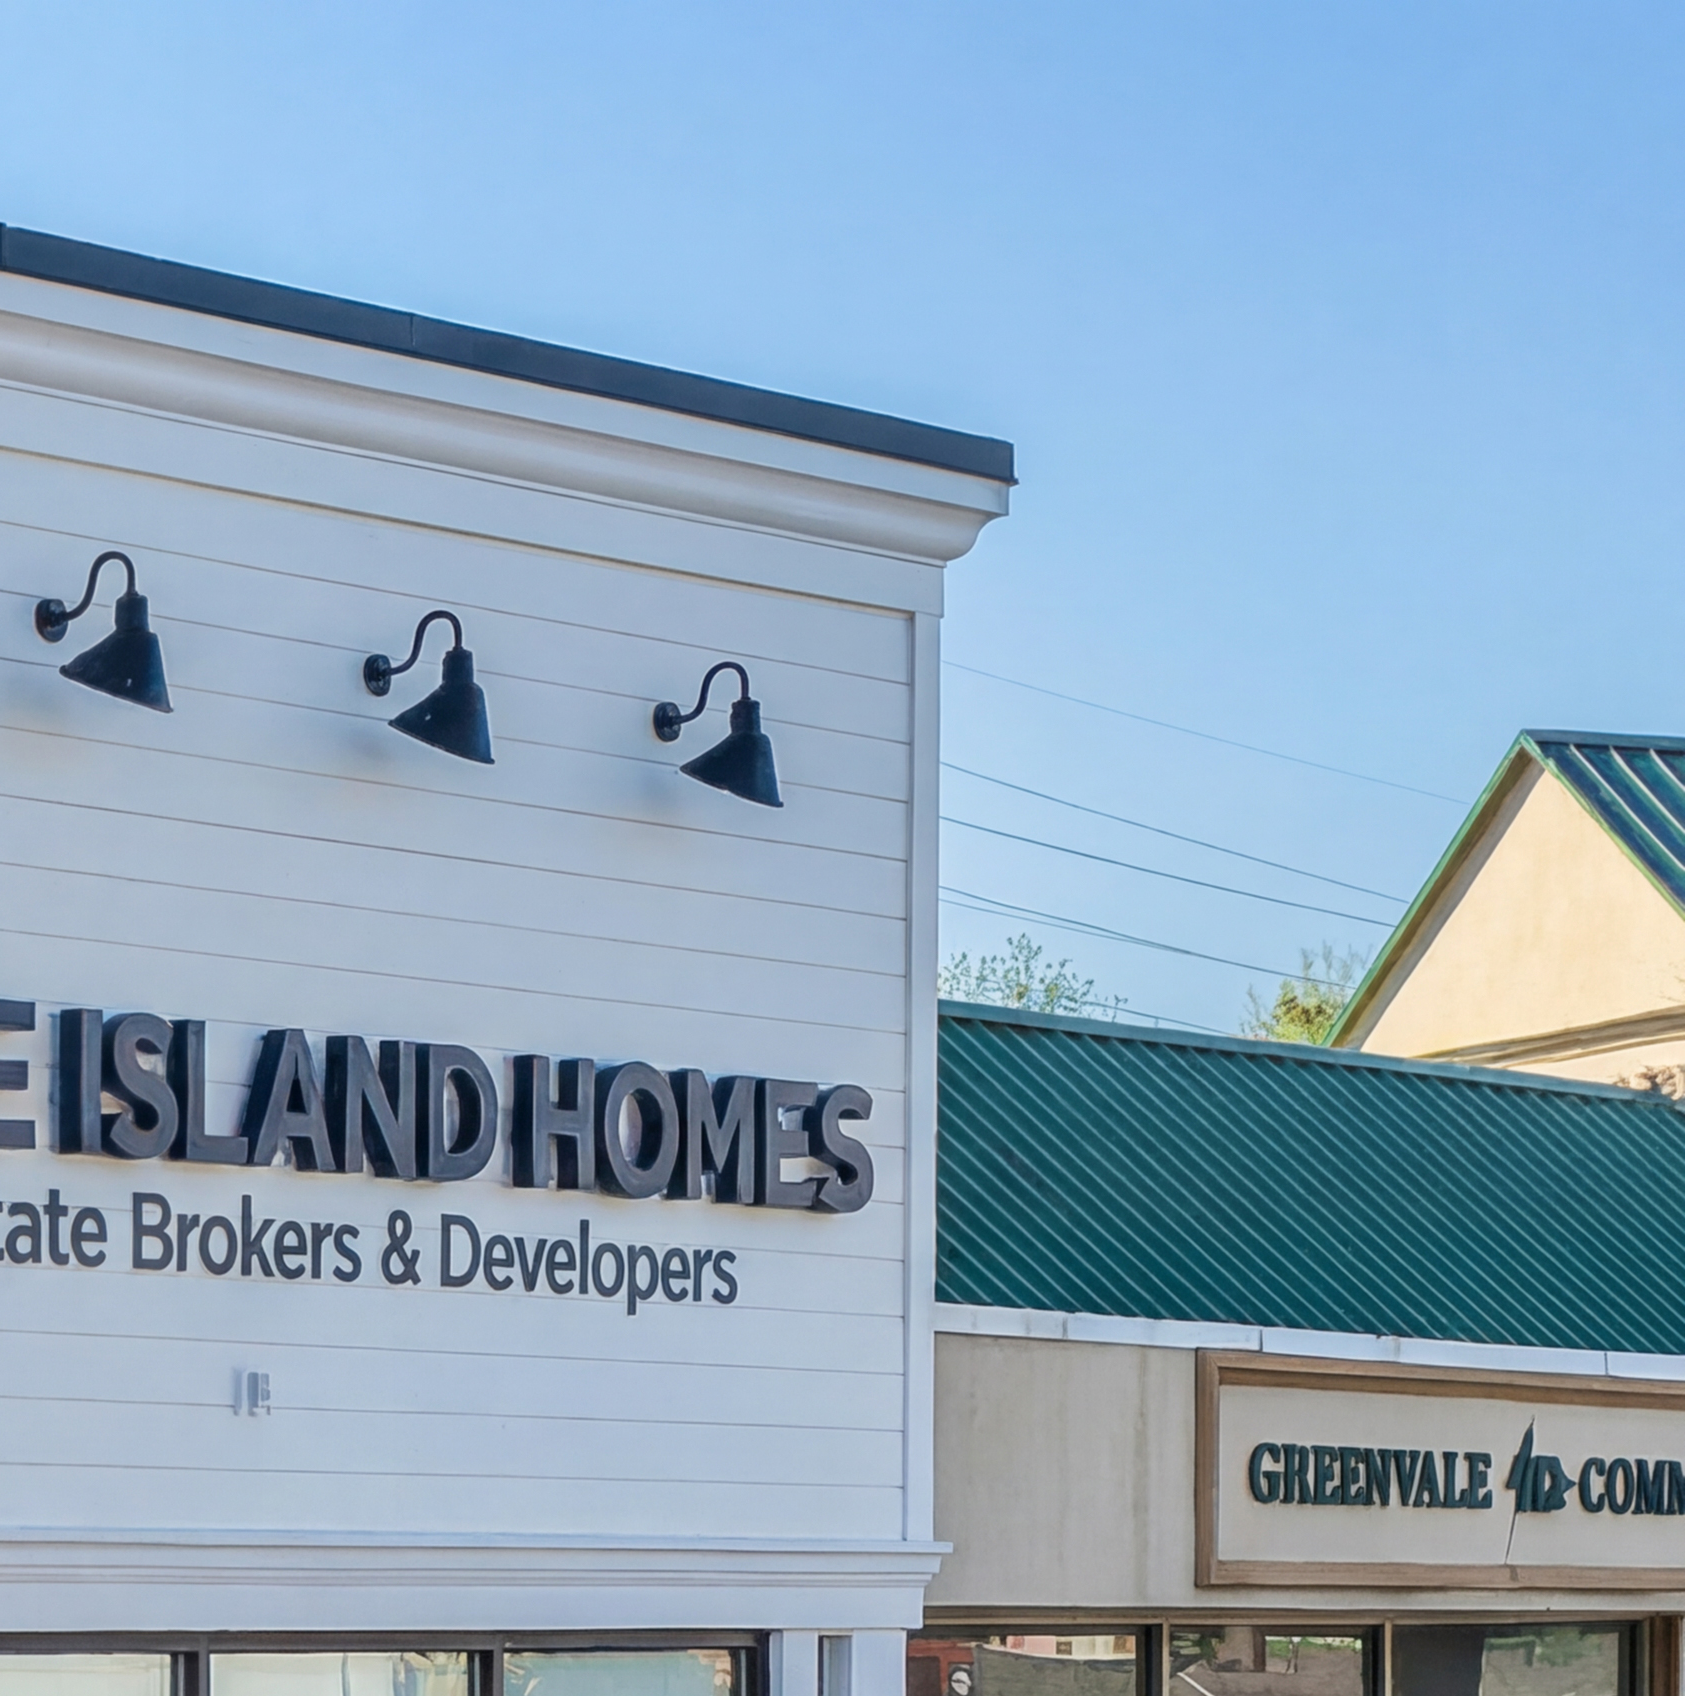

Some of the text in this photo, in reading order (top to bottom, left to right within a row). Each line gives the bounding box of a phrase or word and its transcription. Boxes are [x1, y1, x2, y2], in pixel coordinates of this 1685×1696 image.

[54, 1007, 499, 1183] ISLAND
[511, 1053, 875, 1214] HOMES
[132, 1191, 362, 1283] Brokers
[380, 1209, 422, 1286] &
[439, 1213, 738, 1317] Developers
[1247, 1441, 1493, 1510] GREENVALE
